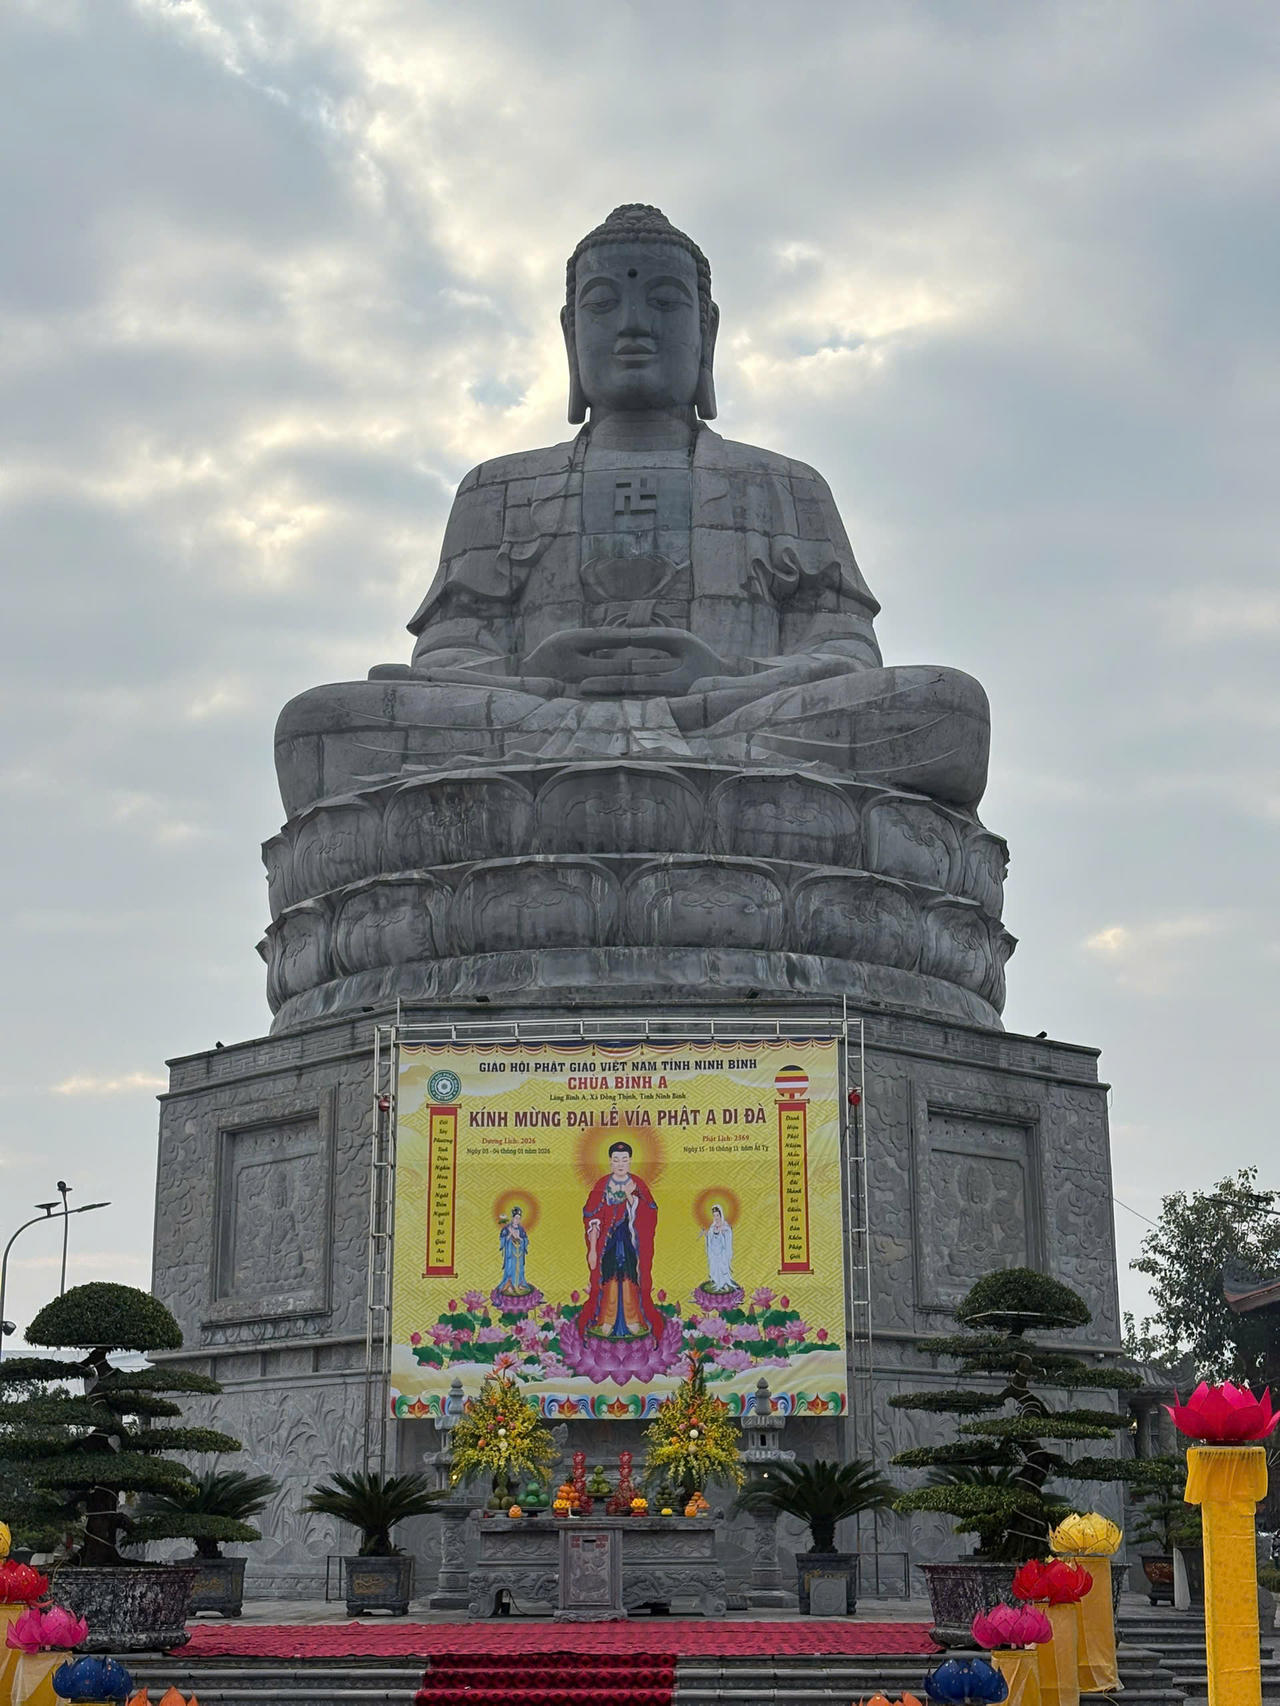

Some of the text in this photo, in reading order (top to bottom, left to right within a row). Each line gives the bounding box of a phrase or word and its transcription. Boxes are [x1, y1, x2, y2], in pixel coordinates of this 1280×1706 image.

[479, 1060, 506, 1073] GIÁO
[510, 1060, 530, 1074] HỘI
[534, 1060, 566, 1074] PHẬT
[569, 1060, 596, 1073] GIÁO
[600, 1058, 627, 1073] VIỆT
[631, 1061, 657, 1071] NAM
[694, 1059, 724, 1070] NINH
[728, 1057, 757, 1069] BÌNH
[568, 1074, 668, 1090] CHÙA BÌNH A
[469, 1103, 766, 1131] KÍNH MỪNG ĐẠI LỄ VÍA PHẬT A DI ĐÀ
[734, 1134, 749, 1142] 2569
